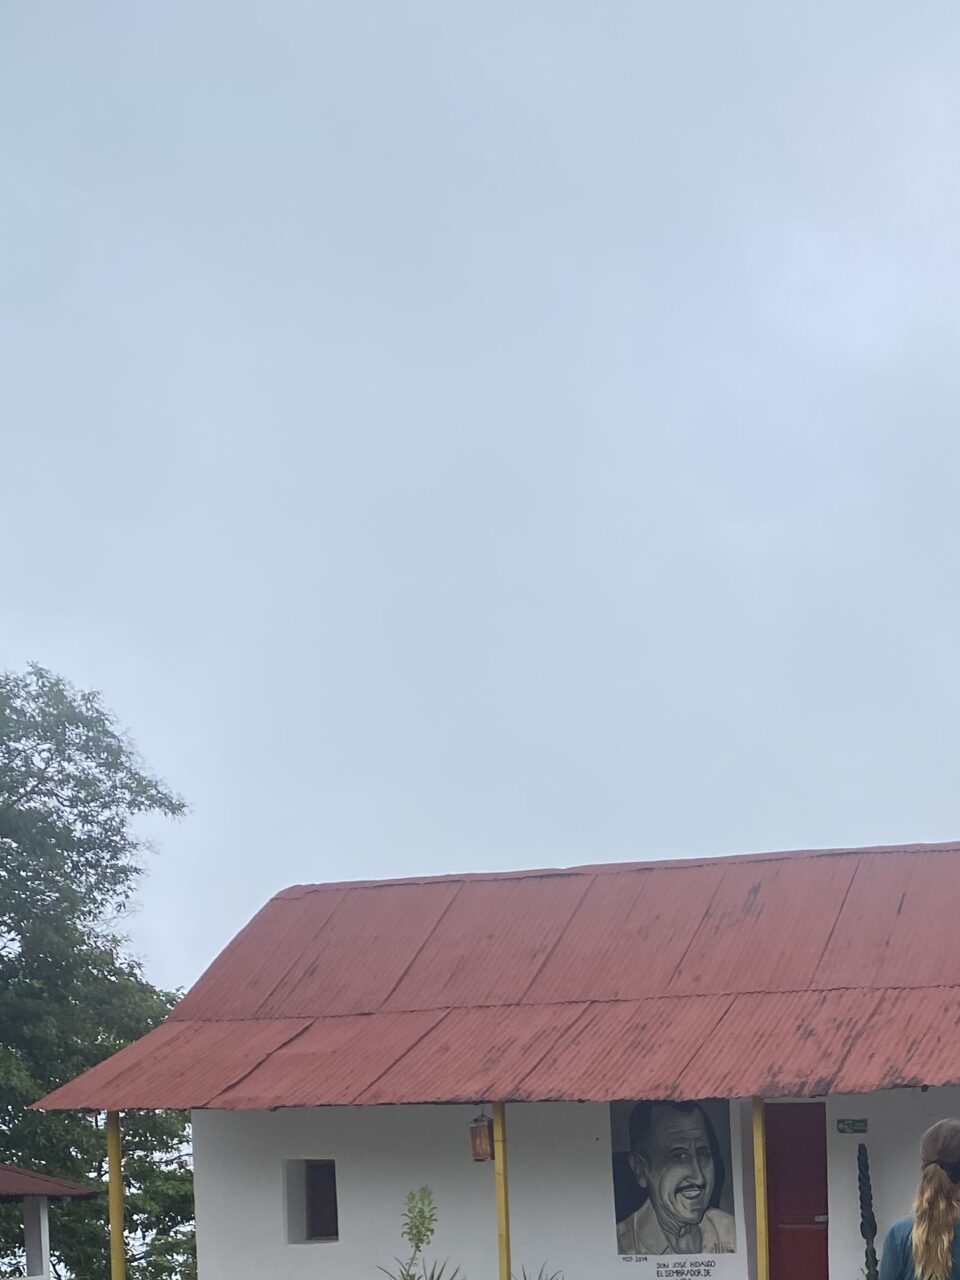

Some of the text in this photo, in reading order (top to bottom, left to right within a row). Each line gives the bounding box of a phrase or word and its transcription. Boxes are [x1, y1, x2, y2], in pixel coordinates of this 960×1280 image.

[689, 1260, 716, 1268] HIDALGO
[664, 1269, 703, 1277] SEMBRADOR
[704, 1269, 712, 1277] DE
